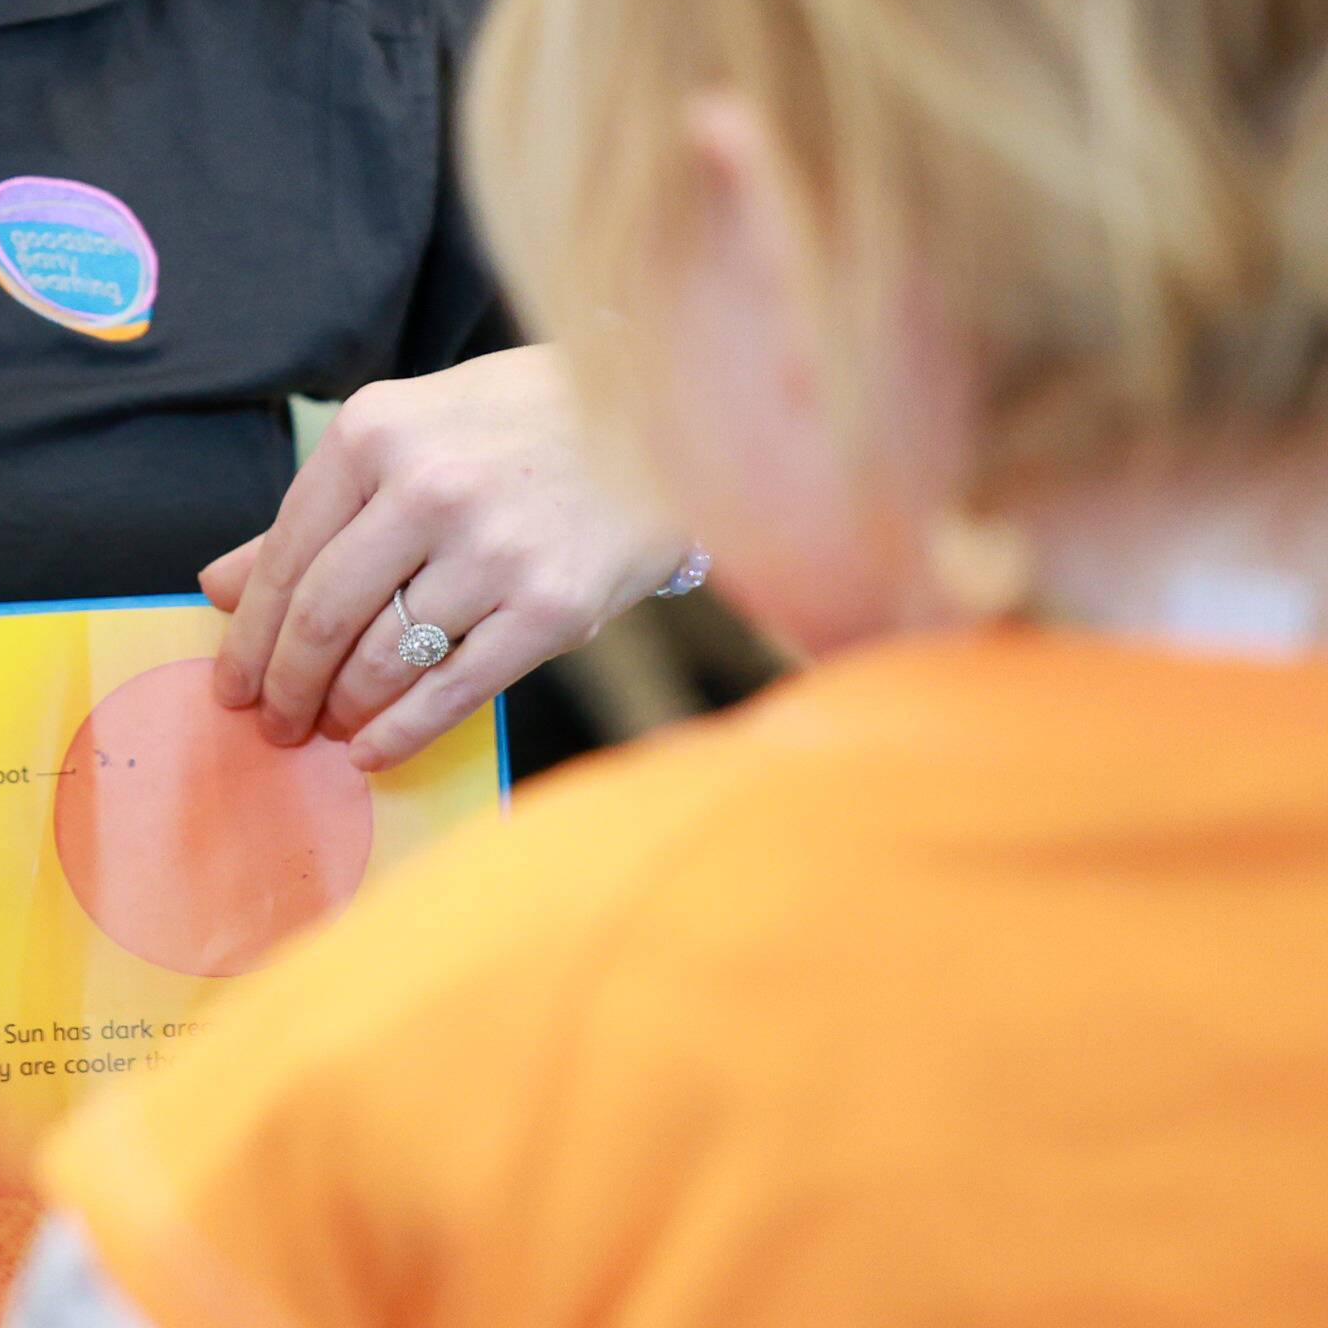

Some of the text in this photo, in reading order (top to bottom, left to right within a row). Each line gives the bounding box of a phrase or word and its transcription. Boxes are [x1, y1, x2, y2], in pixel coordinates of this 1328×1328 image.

[5, 1024, 44, 1044] Sun
[53, 1023, 92, 1041] has
[101, 1019, 153, 1040] dark
[20, 1060, 55, 1077] are
[64, 1053, 136, 1074] cooler
